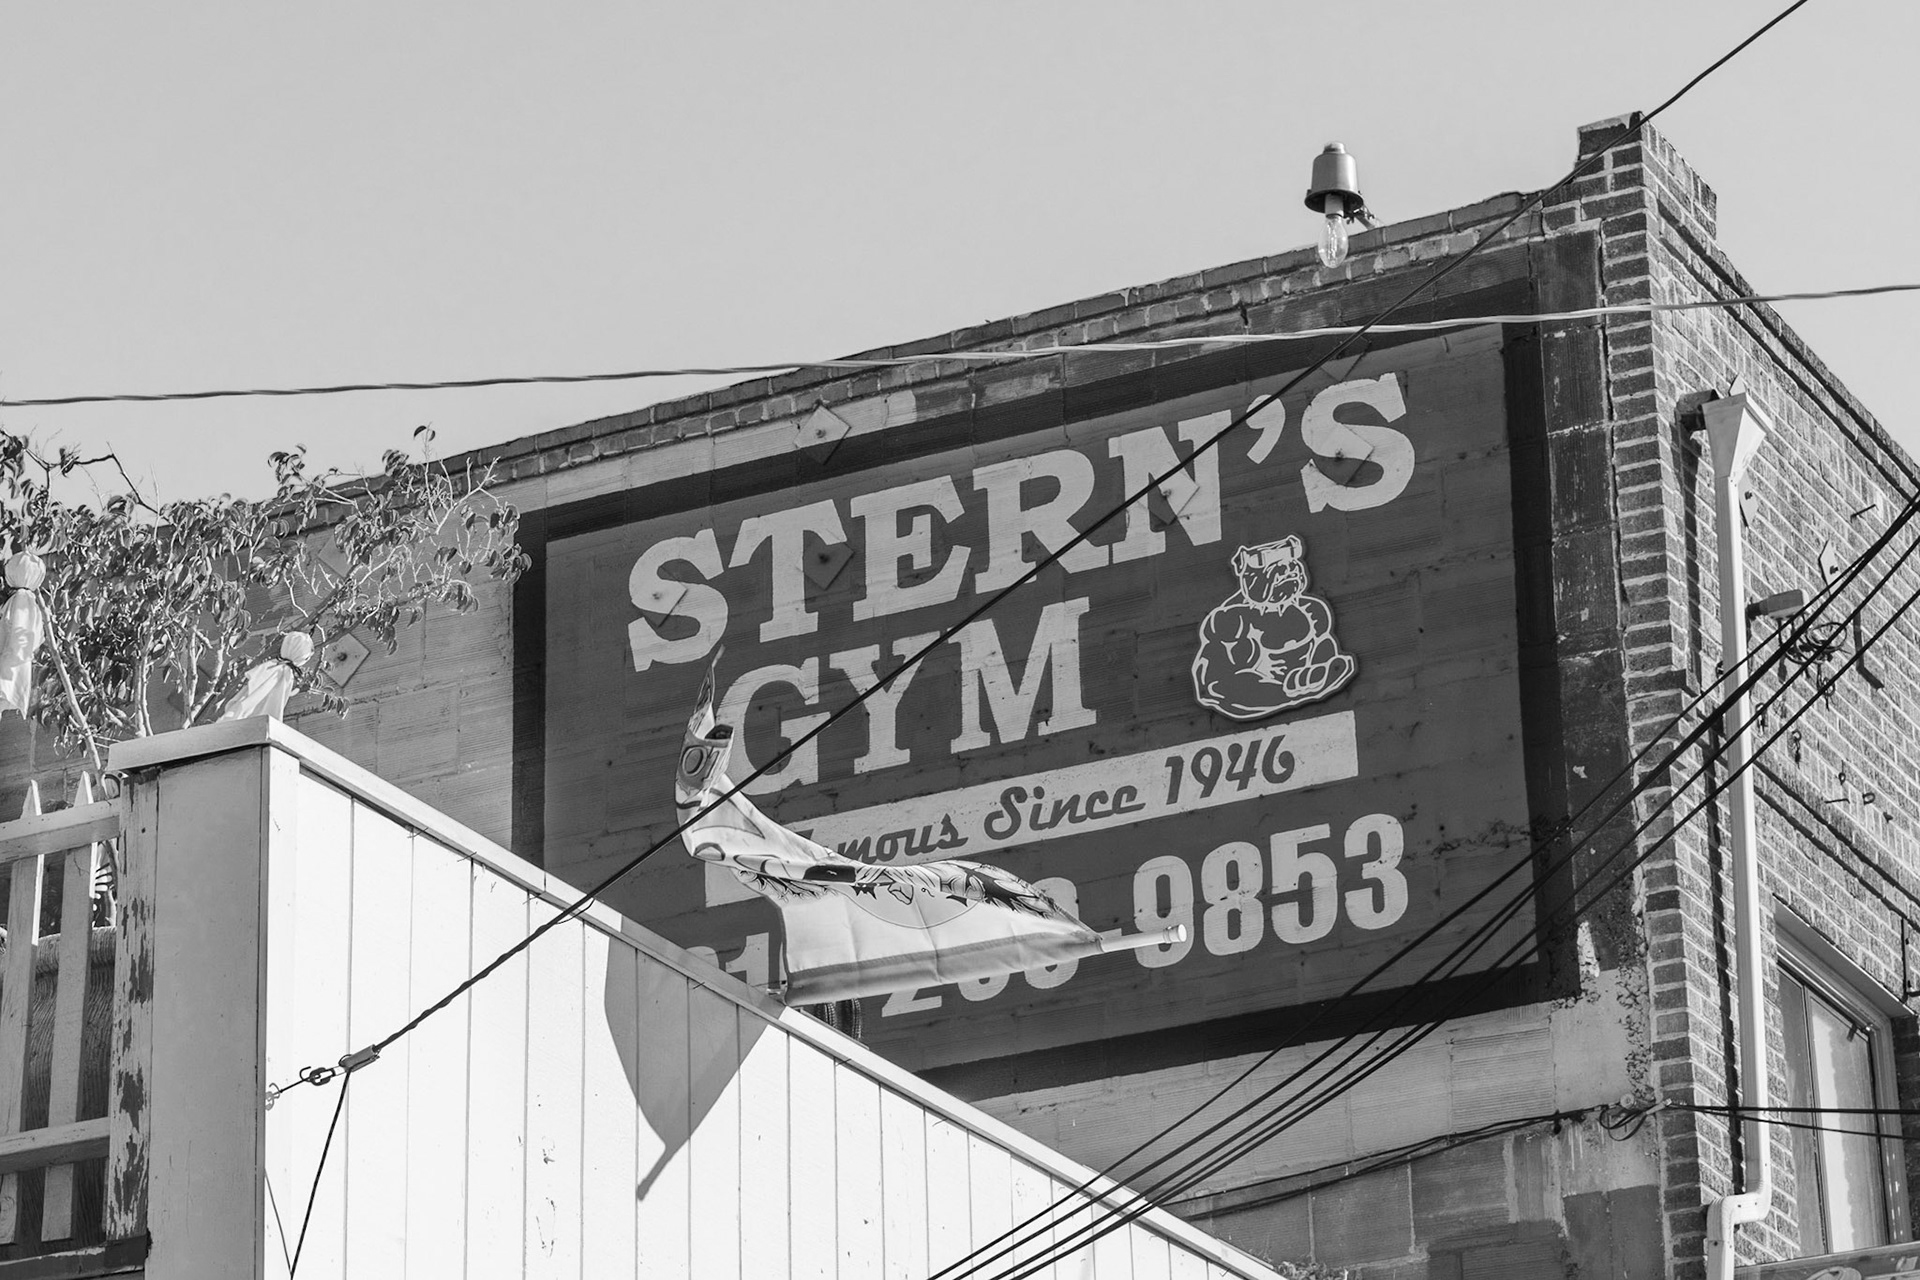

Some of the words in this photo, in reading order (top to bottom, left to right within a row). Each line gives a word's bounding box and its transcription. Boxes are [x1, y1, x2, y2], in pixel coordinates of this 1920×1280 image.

[715, 596, 1097, 796] GYM
[793, 813, 969, 864] mous
[983, 785, 1146, 841] Since
[1164, 734, 1296, 805] 1946
